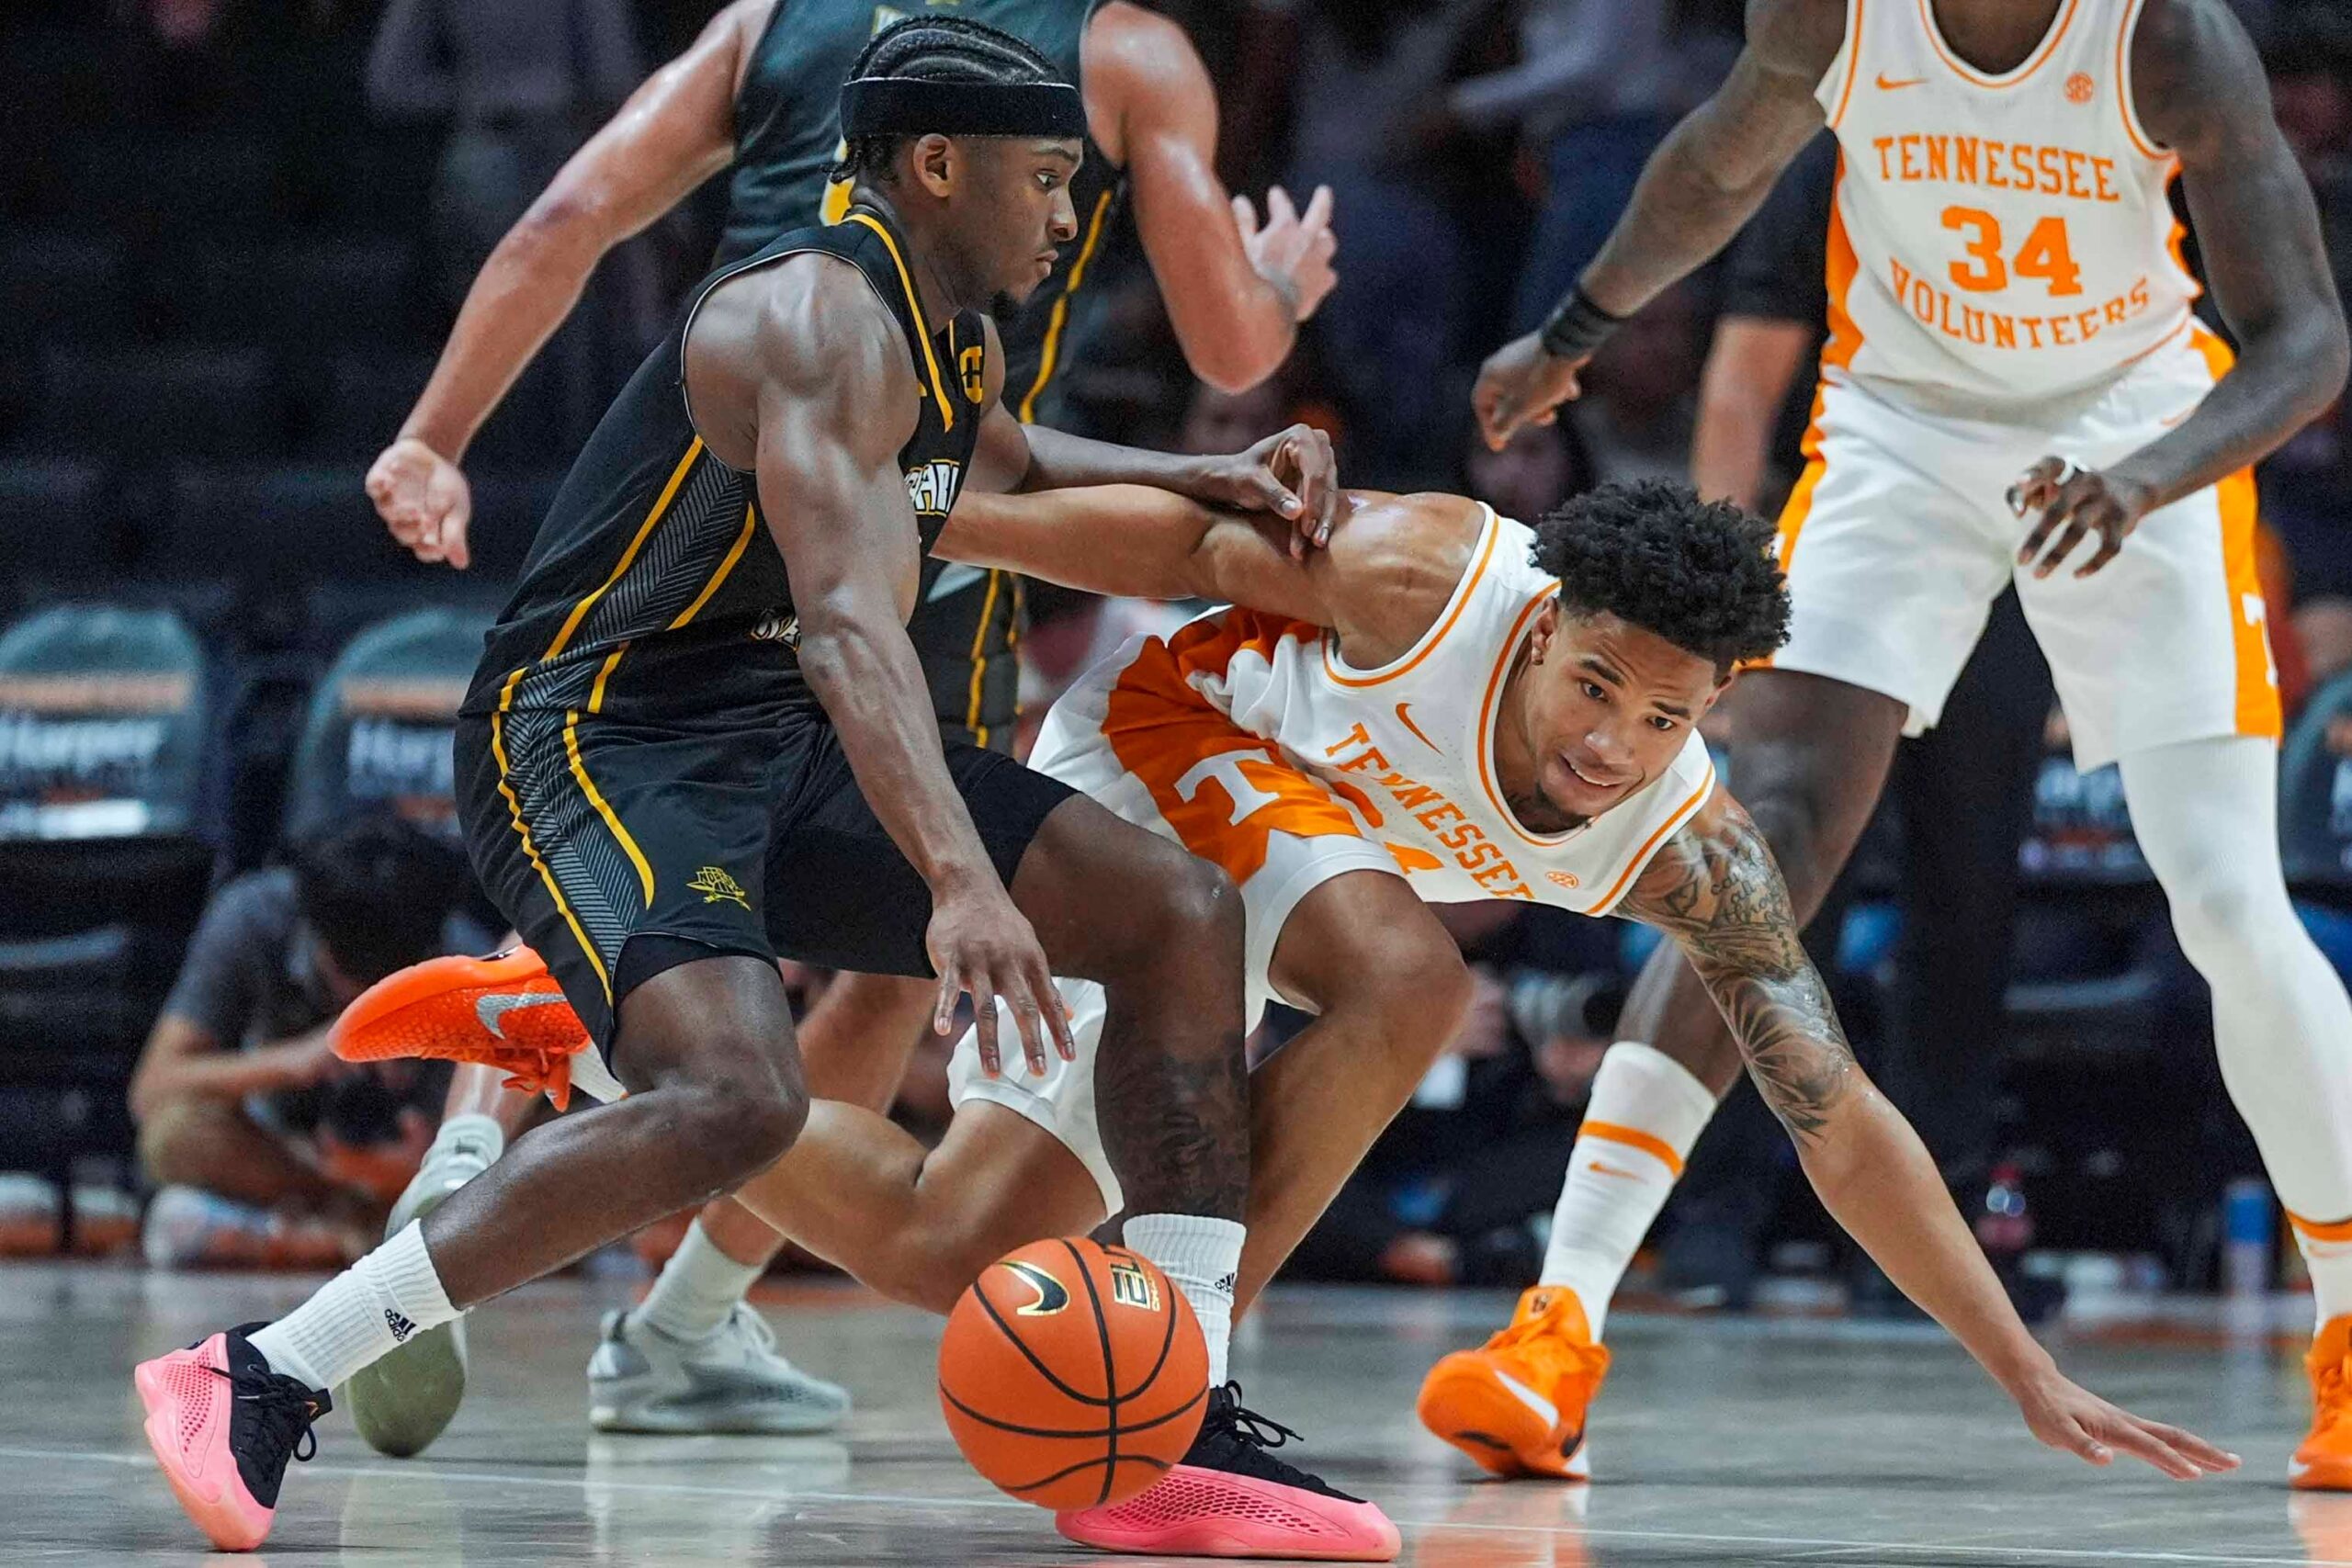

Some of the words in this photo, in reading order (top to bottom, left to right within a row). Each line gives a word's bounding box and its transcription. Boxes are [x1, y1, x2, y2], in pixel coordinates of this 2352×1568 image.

[1871, 133, 2122, 203] TENNESSEE
[1939, 204, 2085, 298] 34
[1889, 256, 2151, 350] VOLUNTEERS
